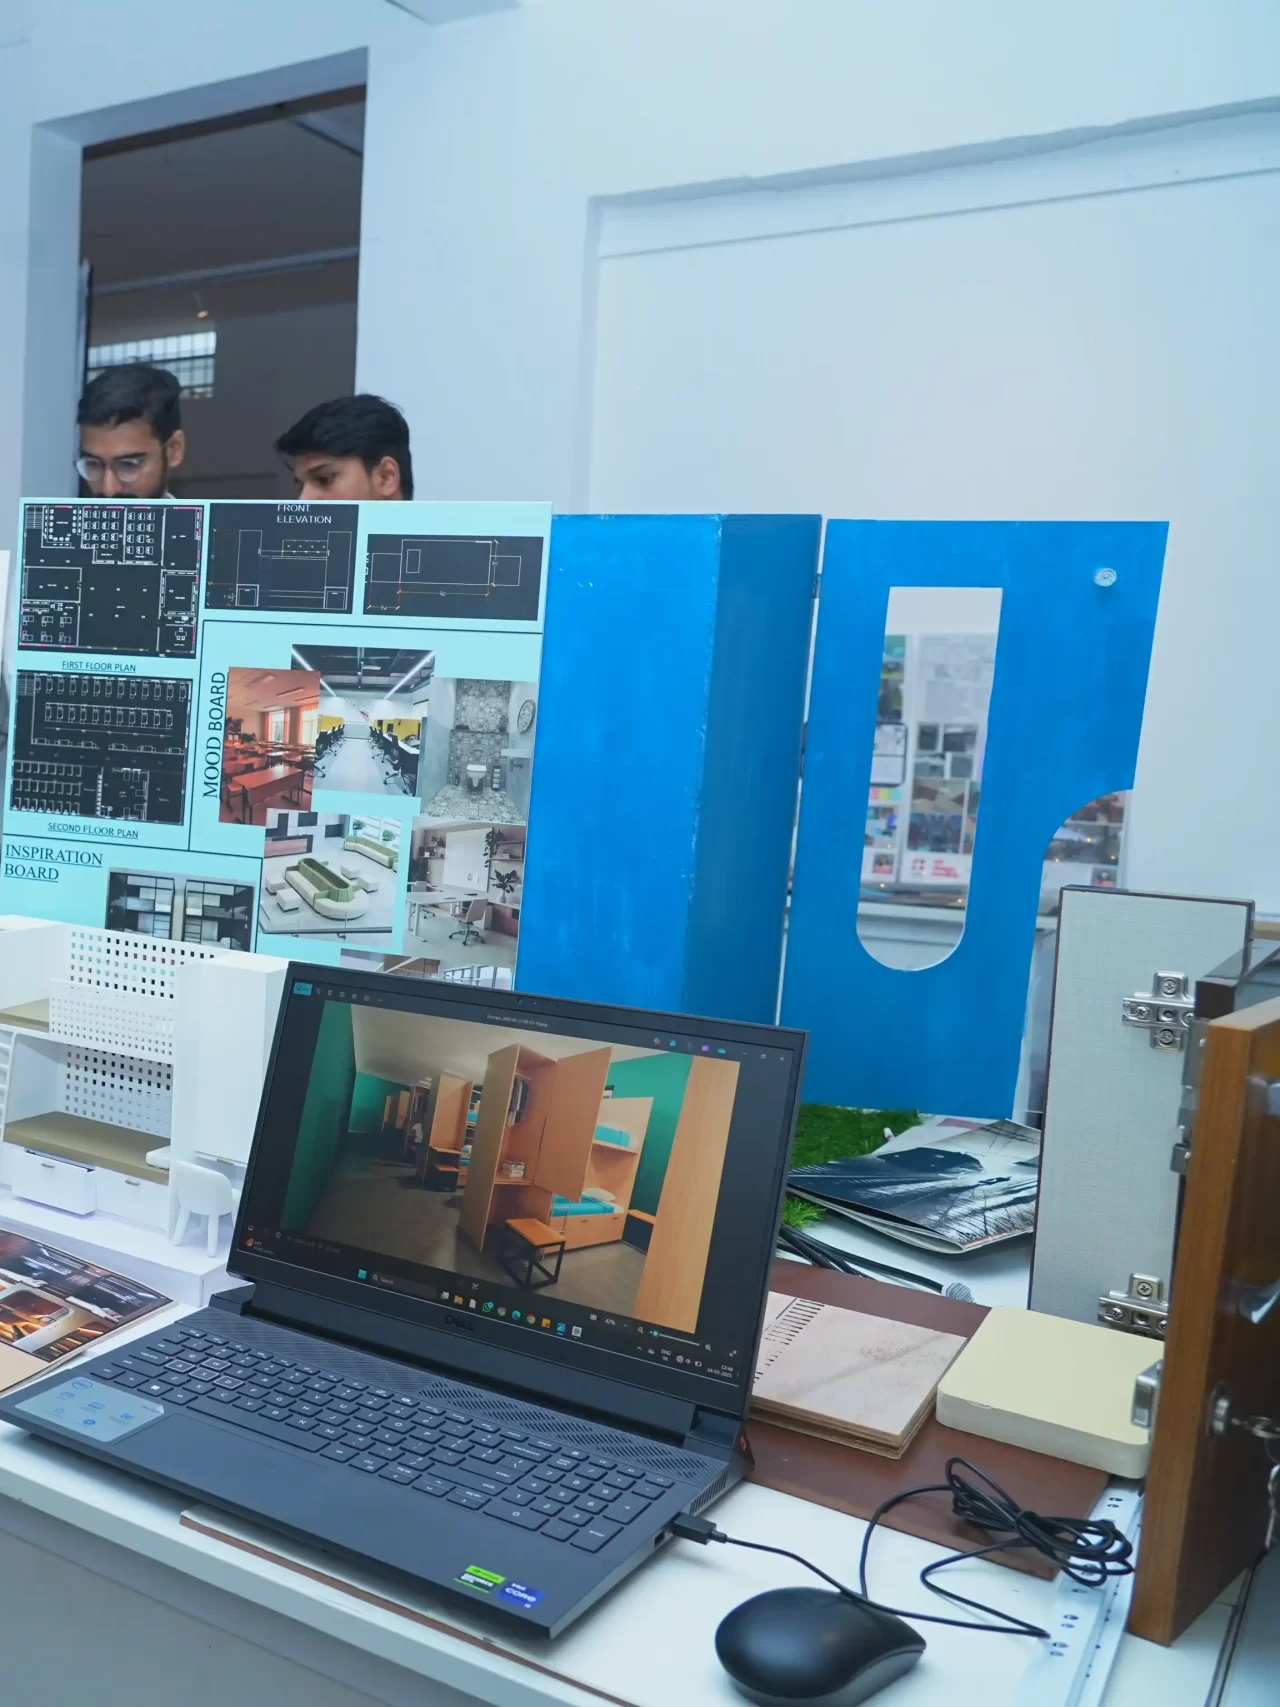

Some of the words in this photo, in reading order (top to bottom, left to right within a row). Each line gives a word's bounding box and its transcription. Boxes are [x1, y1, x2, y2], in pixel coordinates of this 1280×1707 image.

[277, 504, 311, 513] FRONT
[276, 515, 332, 524] ELEVATION
[62, 661, 84, 669] FIRST
[85, 662, 112, 671] FLOOR
[114, 664, 136, 672] PLAN
[208, 672, 226, 731] BOARD
[203, 736, 221, 798] MOOD
[48, 822, 81, 833] SECOND
[83, 825, 114, 836] FLOOR
[117, 829, 139, 839] PLAN
[4, 844, 103, 865] INSPIRATION
[4, 863, 59, 880] BOARD
[604, 1318, 616, 1326] 42%
